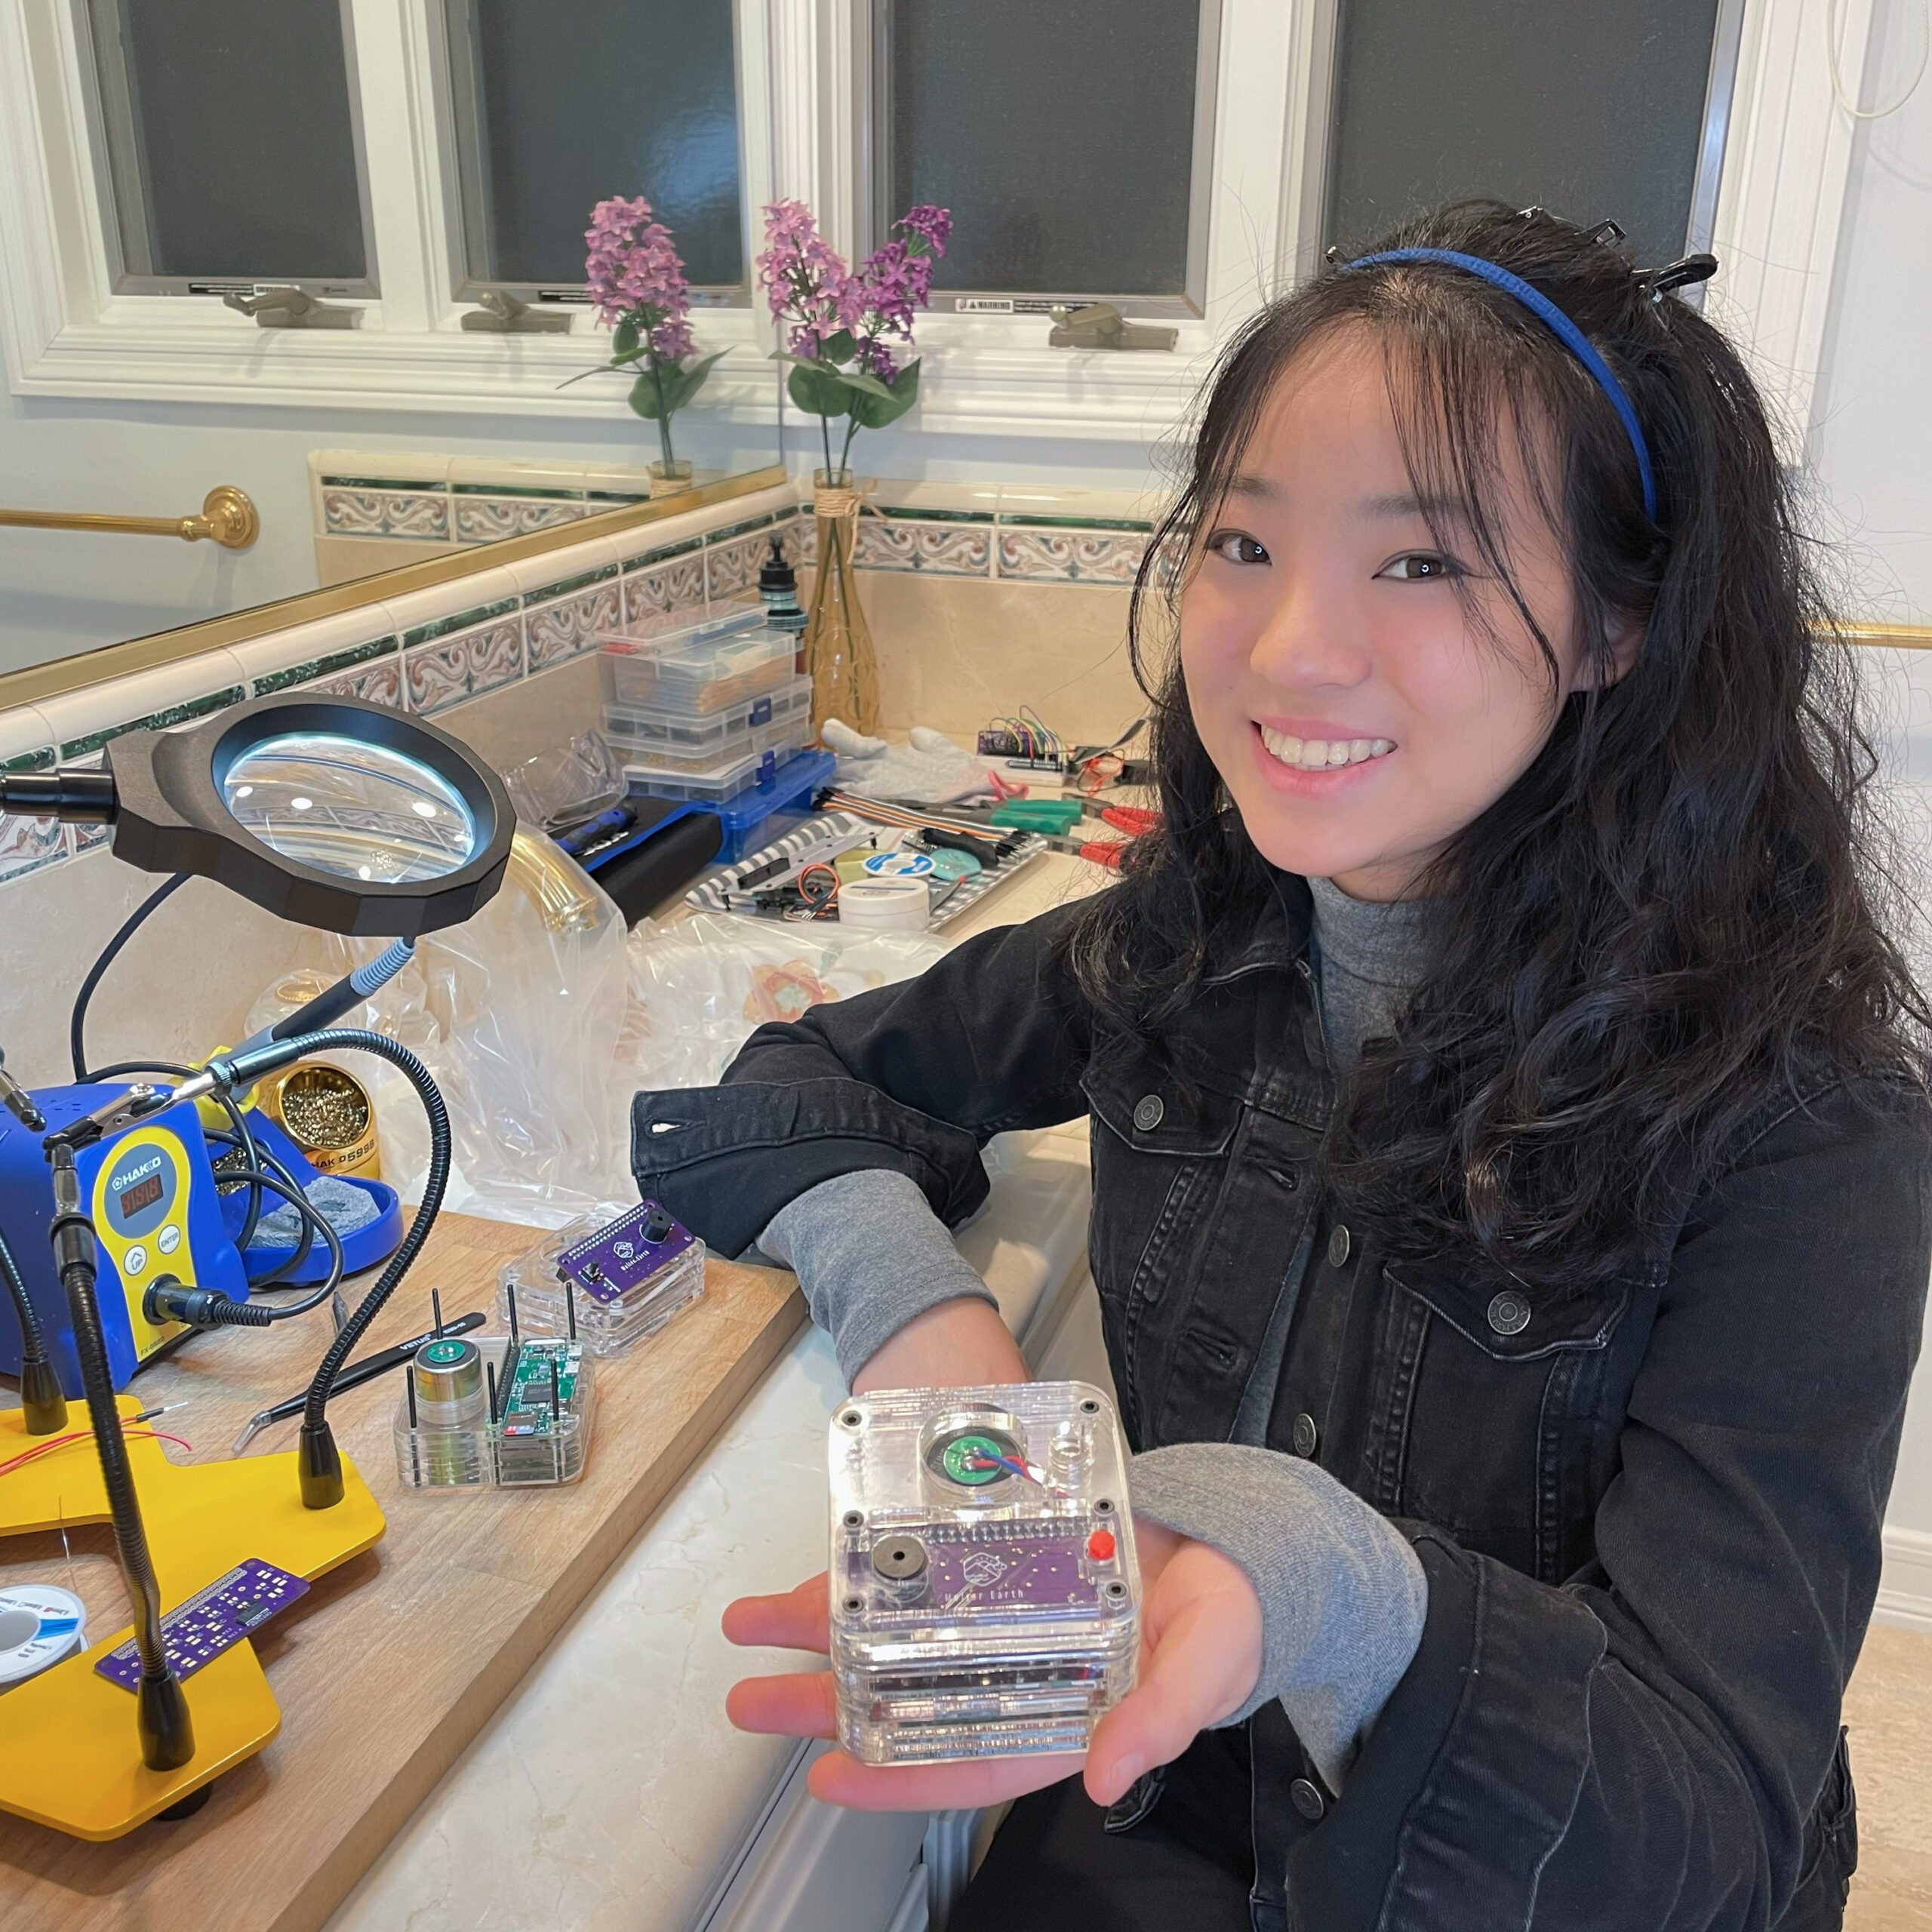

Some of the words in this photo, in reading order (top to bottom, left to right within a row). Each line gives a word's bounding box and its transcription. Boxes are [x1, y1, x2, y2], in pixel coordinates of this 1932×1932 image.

[122, 1155, 162, 1186] HAKKO
[161, 1232, 179, 1247] ENTER
[131, 1258, 143, 1270] UP
[990, 1589, 1023, 1600] Earth
